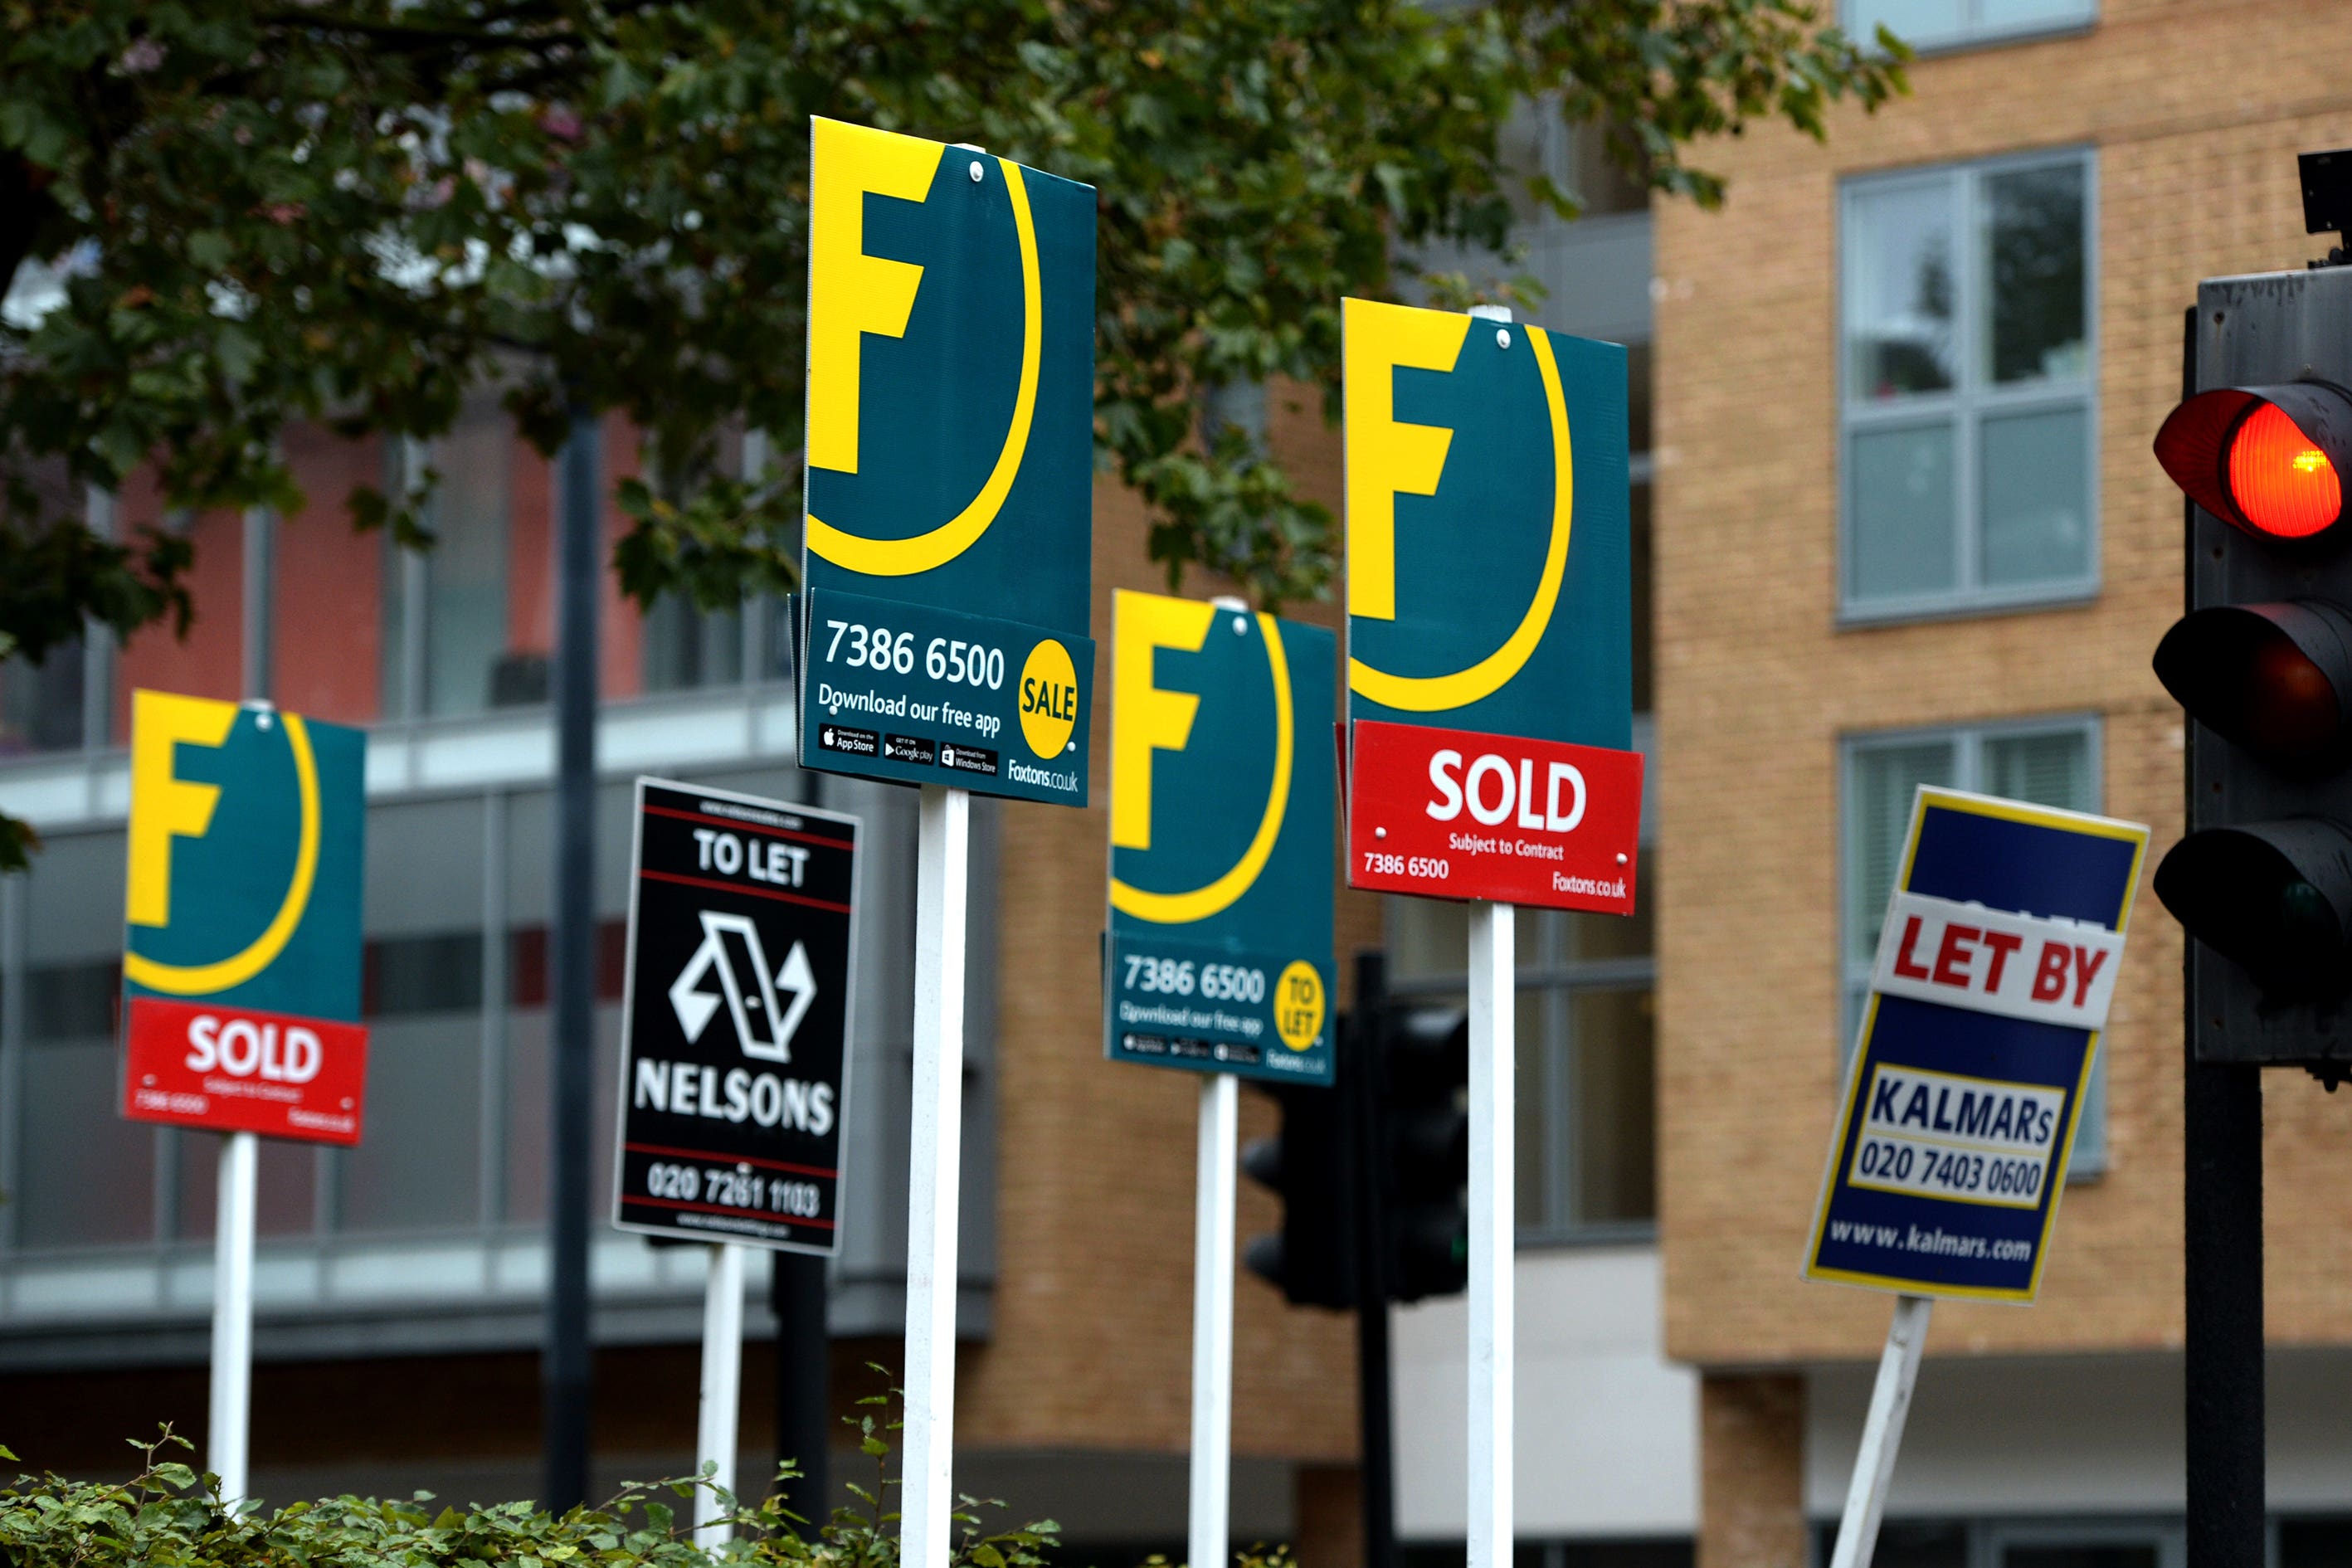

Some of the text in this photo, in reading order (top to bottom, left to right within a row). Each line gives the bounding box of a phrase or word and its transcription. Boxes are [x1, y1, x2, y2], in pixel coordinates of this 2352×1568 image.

[825, 620, 1005, 690] 7386 6500
[818, 684, 1001, 738] Download our free app
[1022, 677, 1075, 722] SALE
[836, 738, 874, 752] App Store
[895, 745, 933, 762] Google play
[956, 757, 981, 771] Windows
[1008, 759, 1079, 792] Foxtons.co.uk
[1425, 749, 1586, 833] SOLD
[694, 829, 811, 888] TO LET
[1364, 852, 1449, 879] 7386 6500
[1449, 833, 1564, 861] Subject to Contract
[1552, 872, 1626, 898] Foxtons.co.uk
[1124, 954, 1265, 1004] 7386 6500
[1893, 914, 2023, 994] LET
[2031, 939, 2110, 1008] BY
[1288, 976, 1317, 1005] TO
[1285, 1010, 1315, 1036] LET
[185, 1014, 323, 1083] SOLD
[634, 1057, 835, 1137] NELSONS
[1871, 1078, 2053, 1146] KALMARs
[648, 1162, 700, 1201] 020
[1861, 1142, 2042, 1196] 020 7403 0600
[1830, 1220, 2032, 1262] www.kalmars.com
